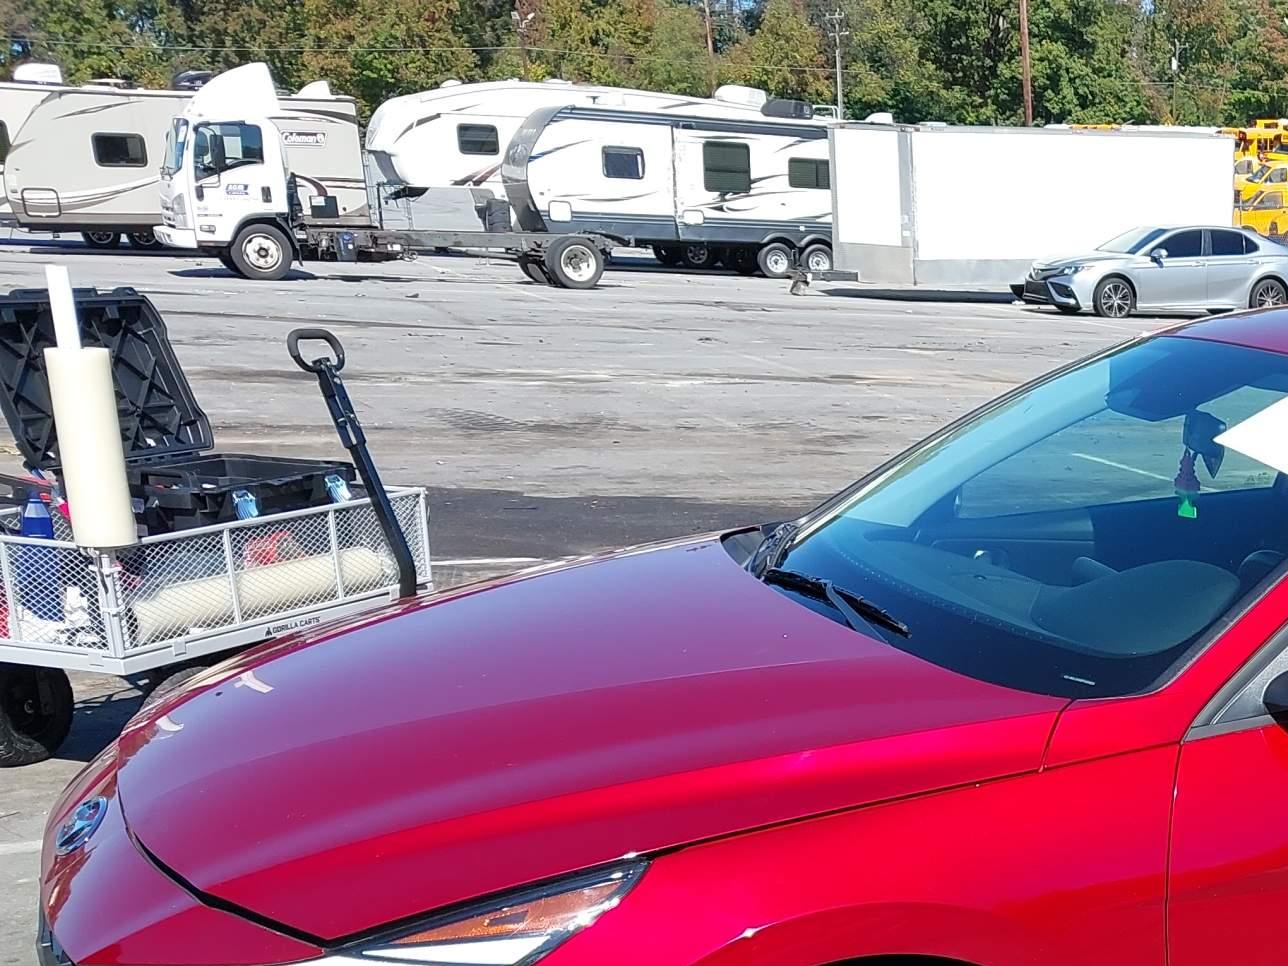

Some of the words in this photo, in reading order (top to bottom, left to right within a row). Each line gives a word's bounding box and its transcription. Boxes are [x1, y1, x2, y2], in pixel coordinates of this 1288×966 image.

[282, 132, 317, 144] Coleman
[272, 622, 299, 634] GORILLA
[300, 616, 320, 627] CARTS
